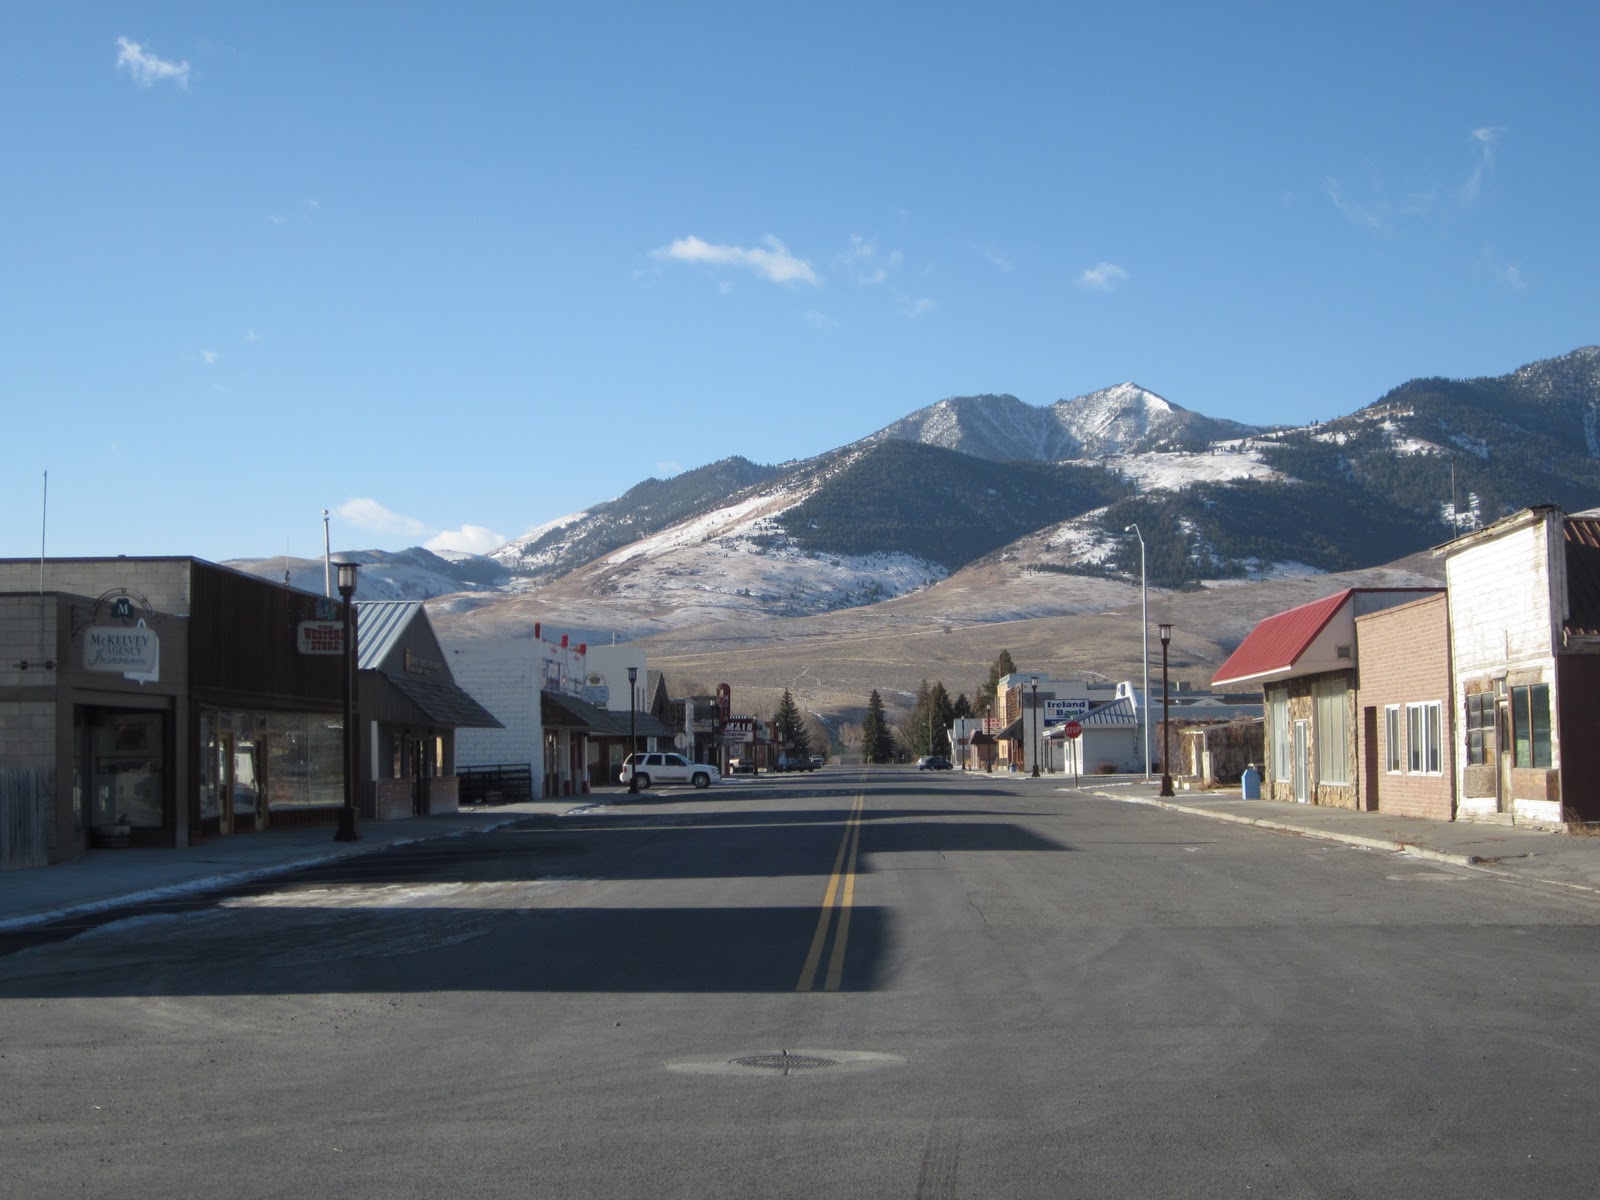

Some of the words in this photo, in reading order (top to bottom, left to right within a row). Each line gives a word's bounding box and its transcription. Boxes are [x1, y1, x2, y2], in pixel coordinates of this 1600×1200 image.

[118, 604, 128, 614] M
[90, 634, 149, 647] McKELVEY
[311, 641, 340, 651] STORE
[107, 647, 143, 657] AGENCY
[1056, 709, 1086, 717] Bank
[725, 722, 753, 731] MAIN
[1065, 726, 1081, 734] STOP
